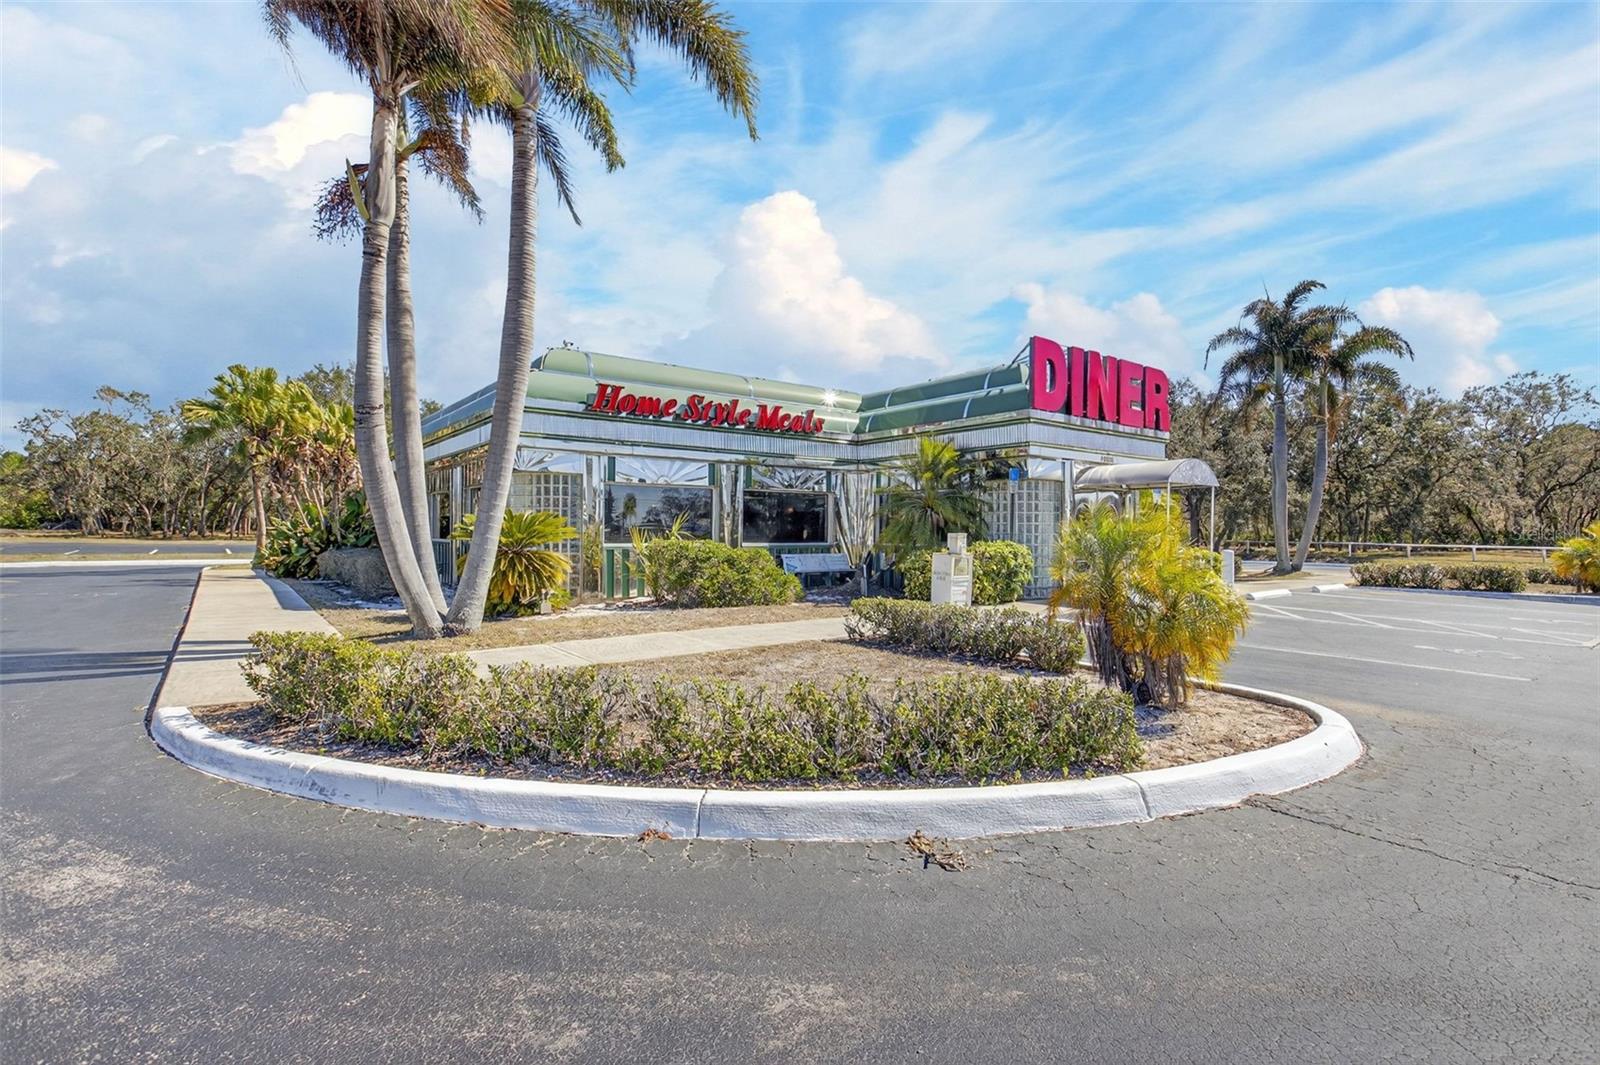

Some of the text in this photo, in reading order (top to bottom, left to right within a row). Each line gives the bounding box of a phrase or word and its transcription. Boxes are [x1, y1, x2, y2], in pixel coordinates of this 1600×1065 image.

[592, 382, 825, 433] Home Style Meals
[1030, 336, 1170, 432] DINER
